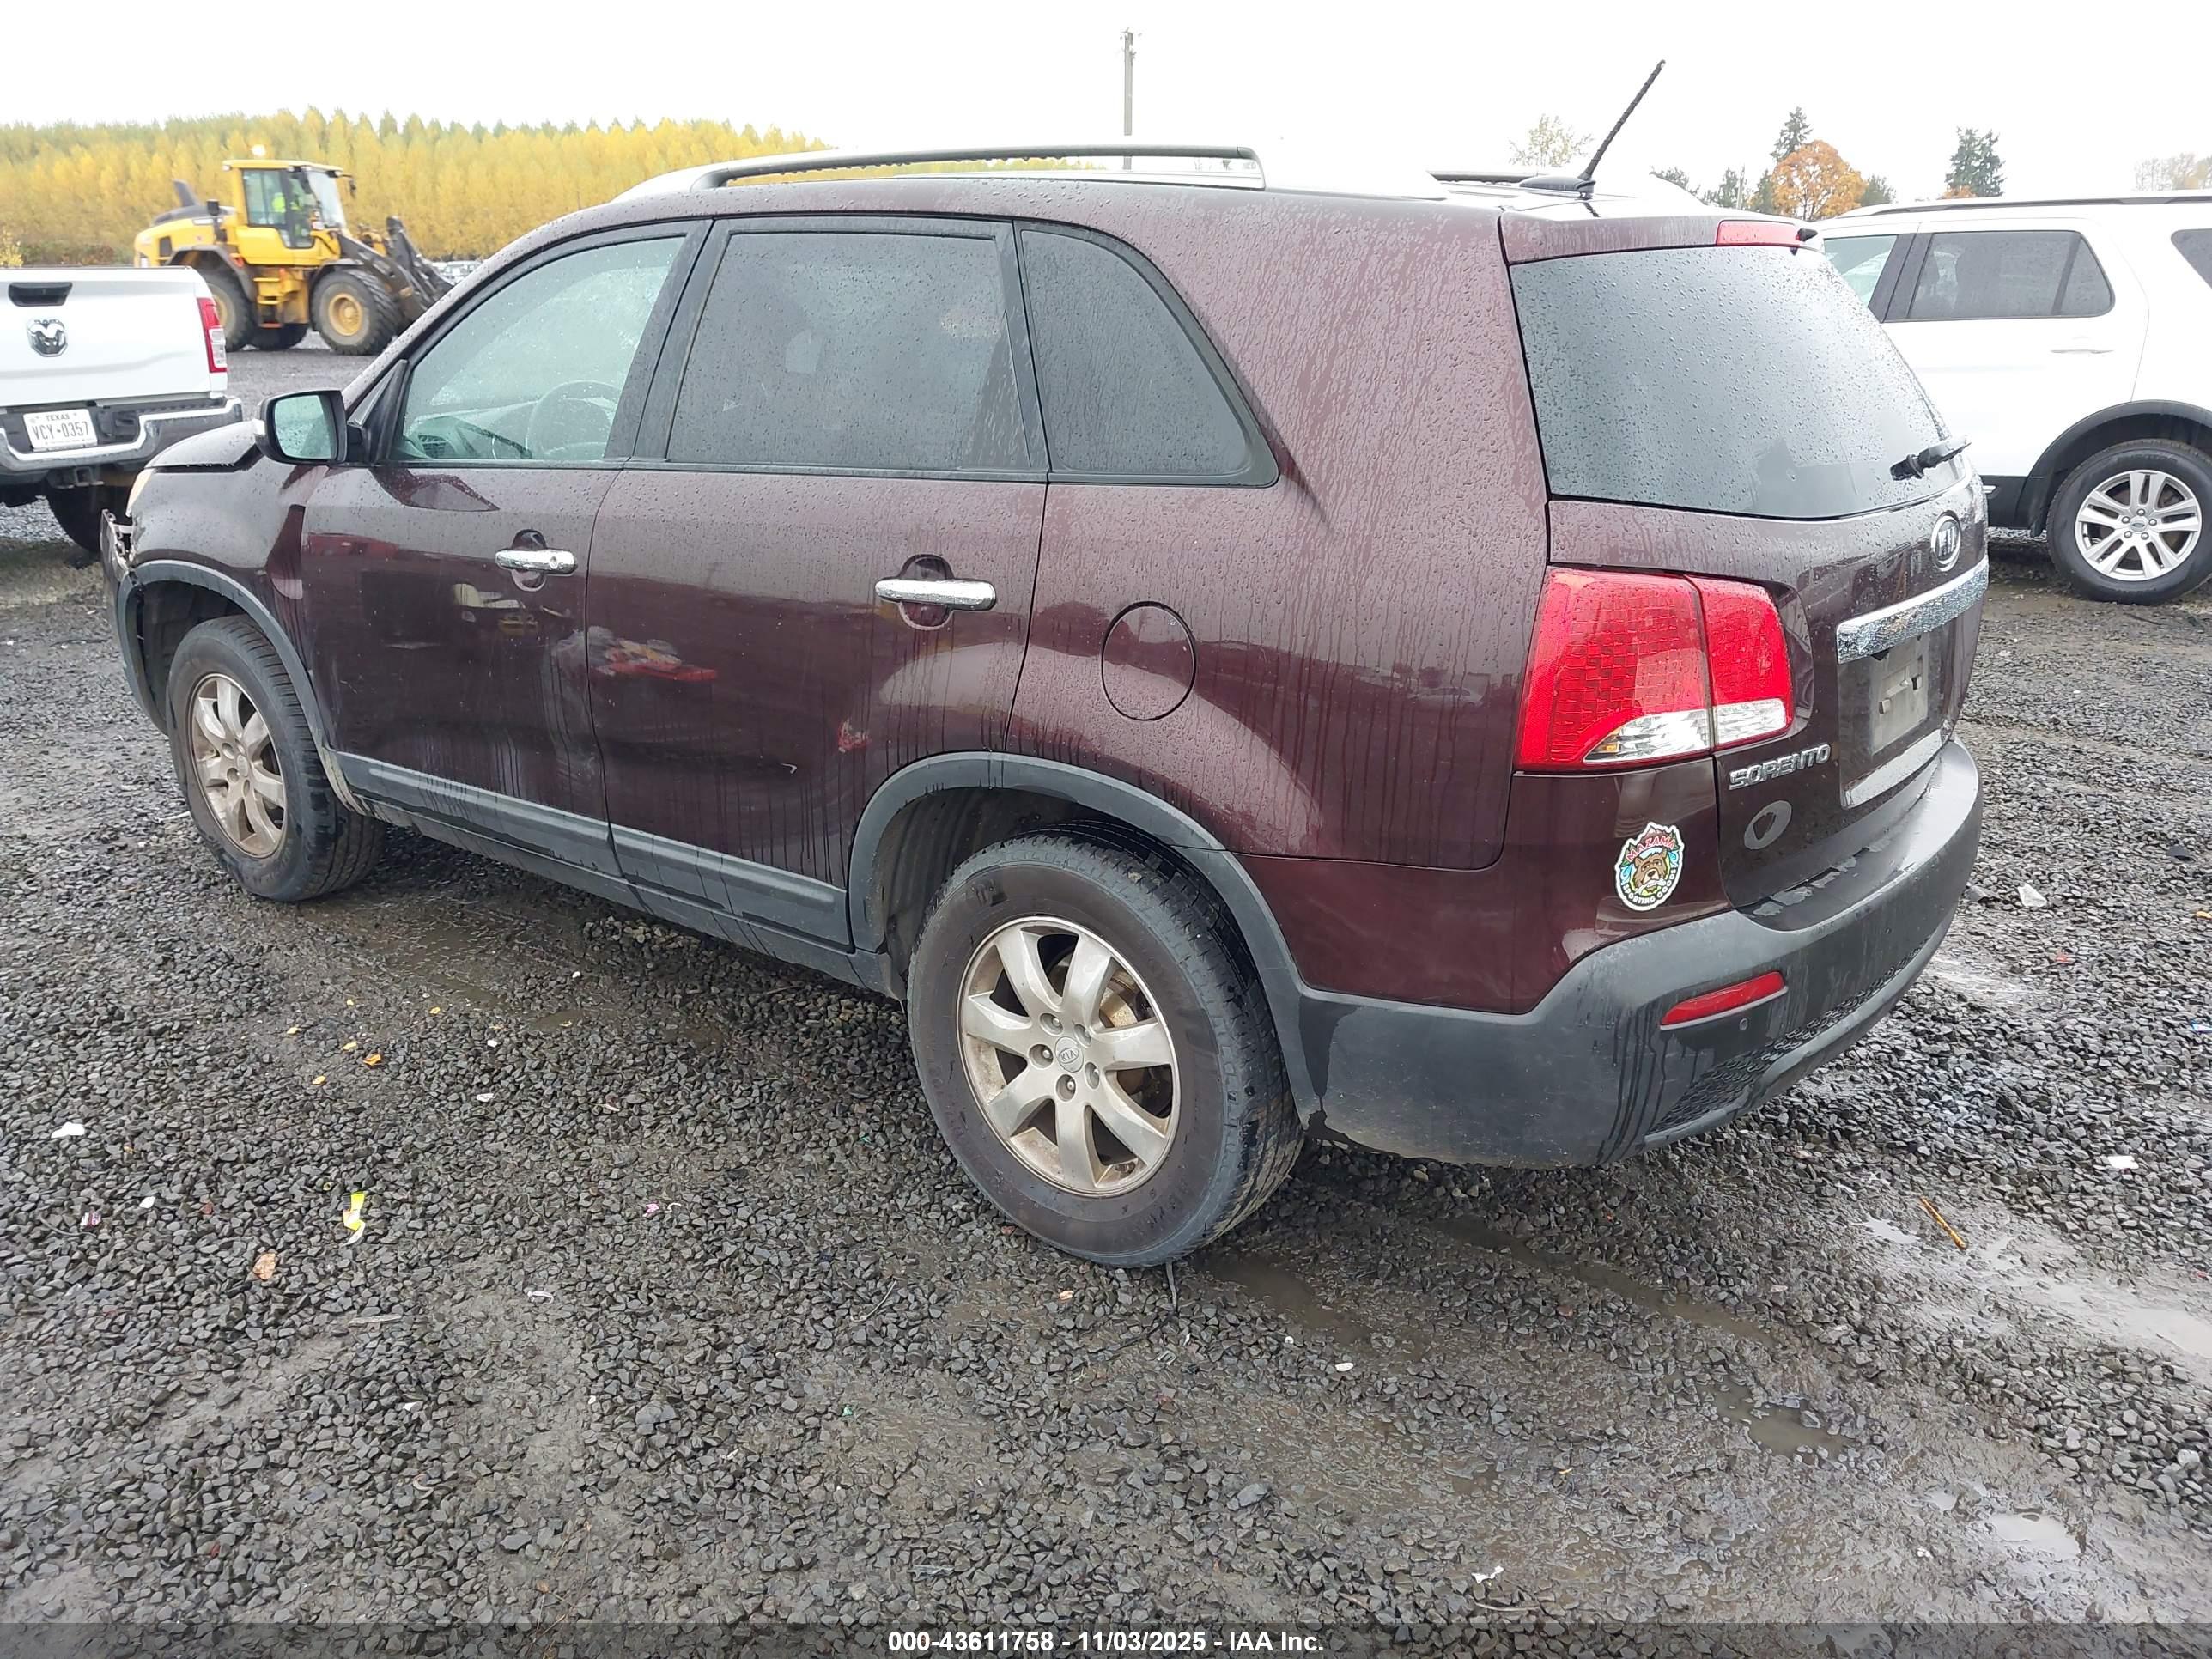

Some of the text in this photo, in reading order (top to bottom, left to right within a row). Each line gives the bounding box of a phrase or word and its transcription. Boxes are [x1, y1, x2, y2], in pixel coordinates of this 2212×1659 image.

[1729, 744, 1831, 791] SORENTO
[1625, 835, 1676, 862] MAZAMA
[1622, 868, 1678, 905] SPORTING GOODS
[1060, 1048, 1079, 1062] KIA
